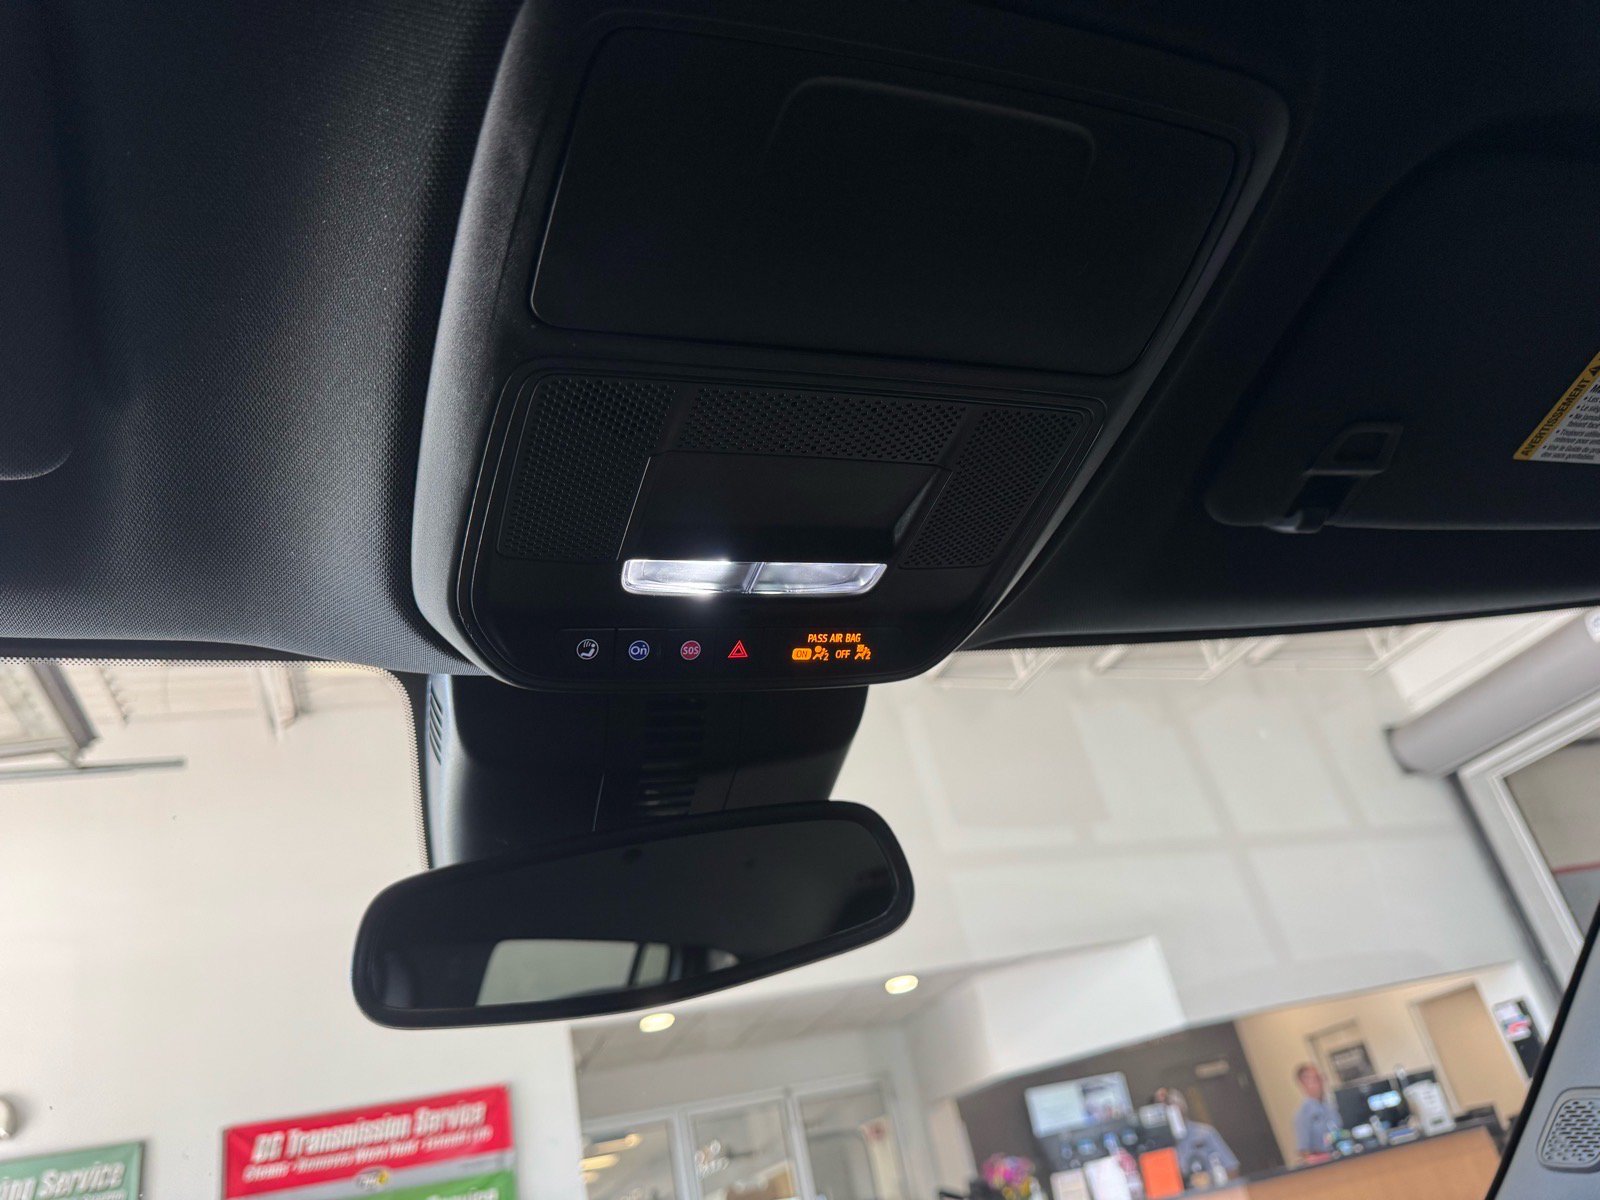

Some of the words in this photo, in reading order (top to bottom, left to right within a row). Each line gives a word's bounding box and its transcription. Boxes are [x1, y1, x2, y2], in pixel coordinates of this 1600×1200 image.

[1521, 378, 1591, 456] AVERTISSEMENT
[807, 633, 828, 643] PASS
[829, 633, 844, 643] AIR
[845, 633, 862, 643] BAG
[682, 645, 700, 656] SOS
[835, 649, 851, 659] OFF
[285, 1112, 412, 1158] Transmission
[413, 1101, 486, 1135] Service
[40, 1162, 126, 1198] Service
